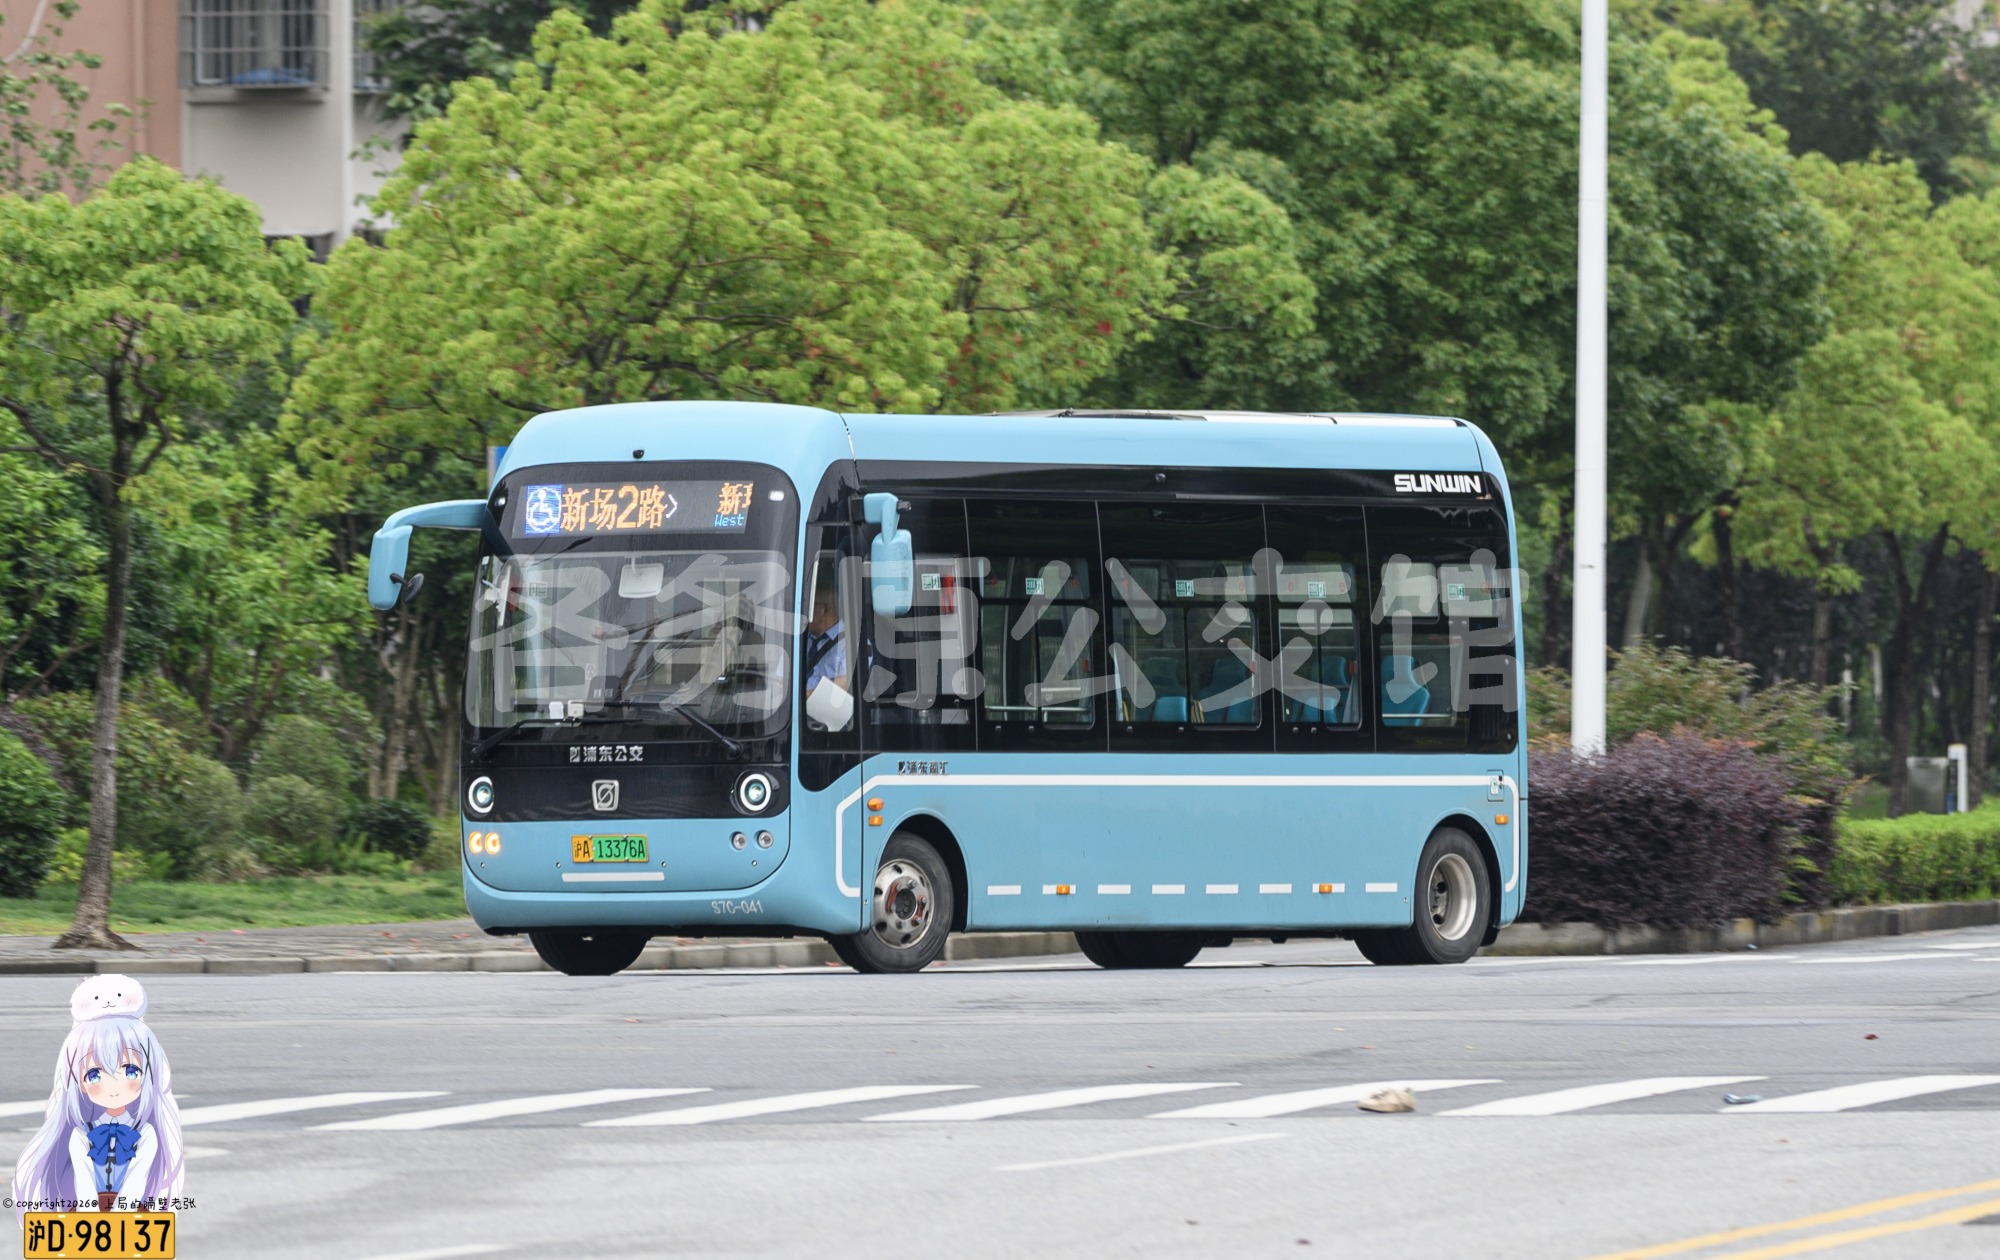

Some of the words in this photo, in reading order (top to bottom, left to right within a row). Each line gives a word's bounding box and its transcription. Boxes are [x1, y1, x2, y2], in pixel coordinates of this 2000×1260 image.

[1394, 474, 1482, 493] SUNWIN
[561, 485, 667, 532] 新场2路
[714, 513, 744, 527] West
[583, 744, 644, 763] 浦东公交
[711, 899, 764, 915] S7C-041
